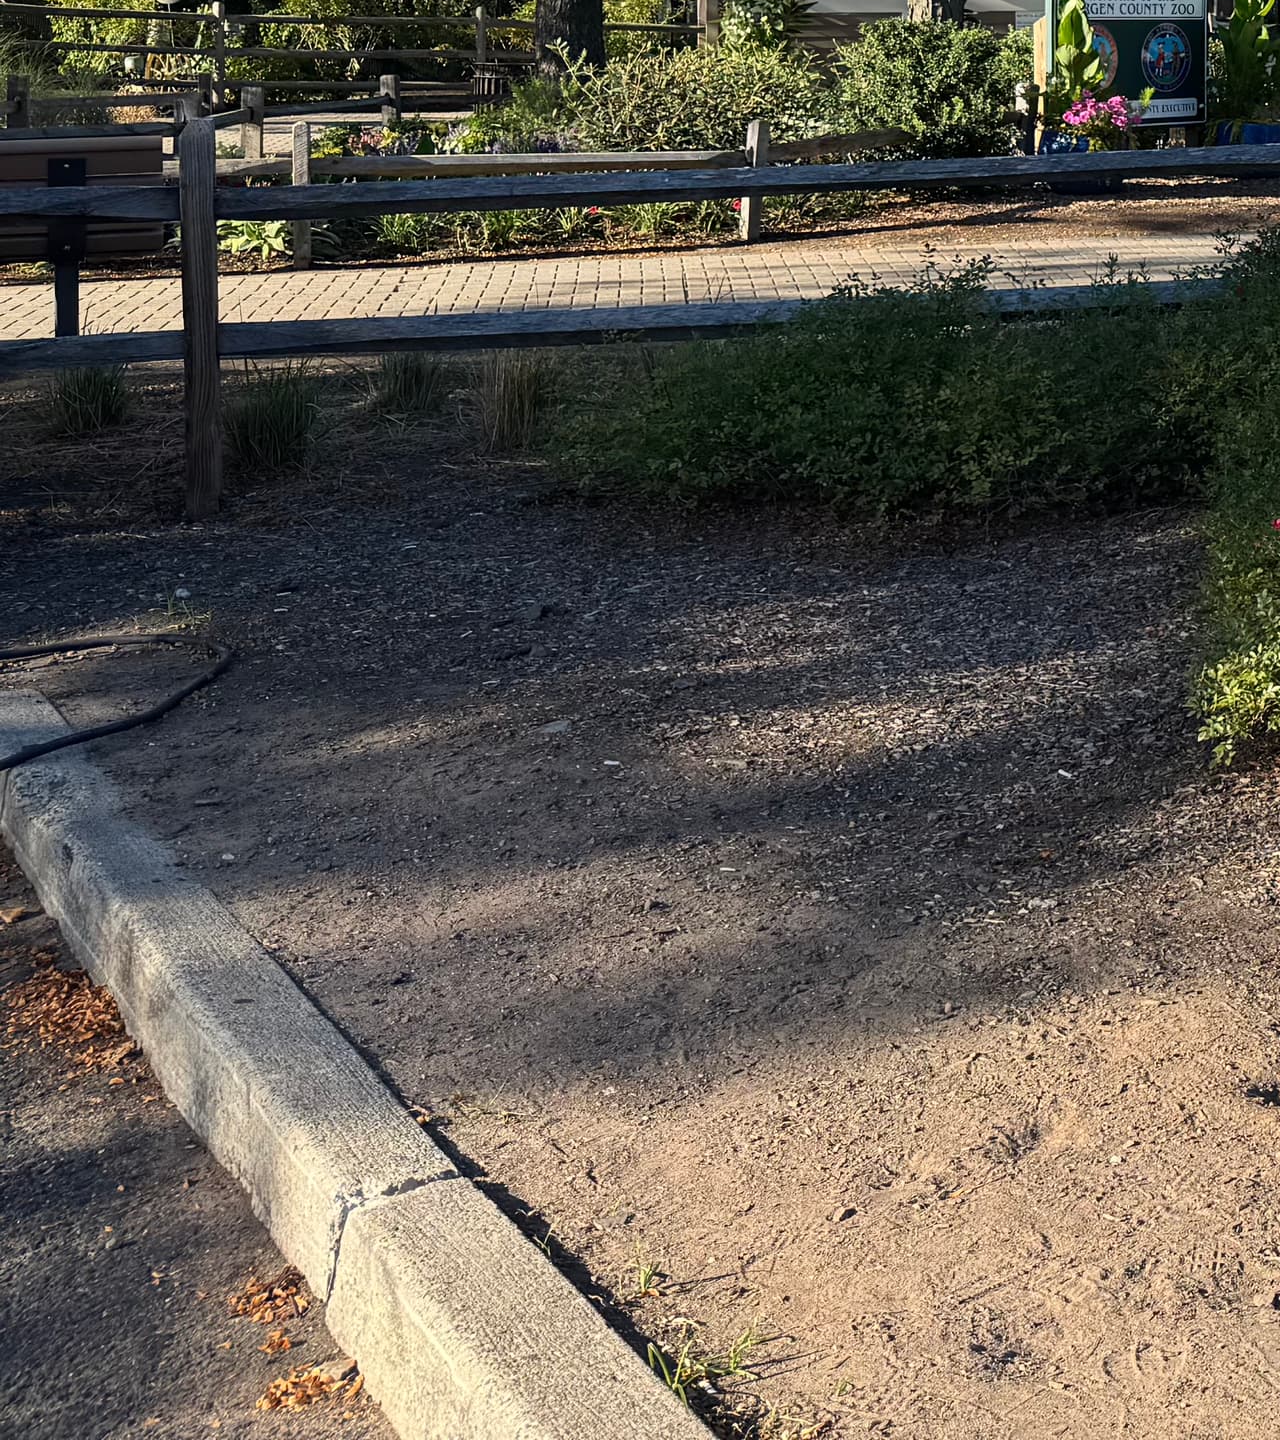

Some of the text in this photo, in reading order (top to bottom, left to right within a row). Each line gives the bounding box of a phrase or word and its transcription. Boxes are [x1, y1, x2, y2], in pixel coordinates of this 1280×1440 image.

[1086, 3, 1195, 16] RGEN COUNTY ZOO
[1161, 102, 1196, 114] EXECUTIVE
